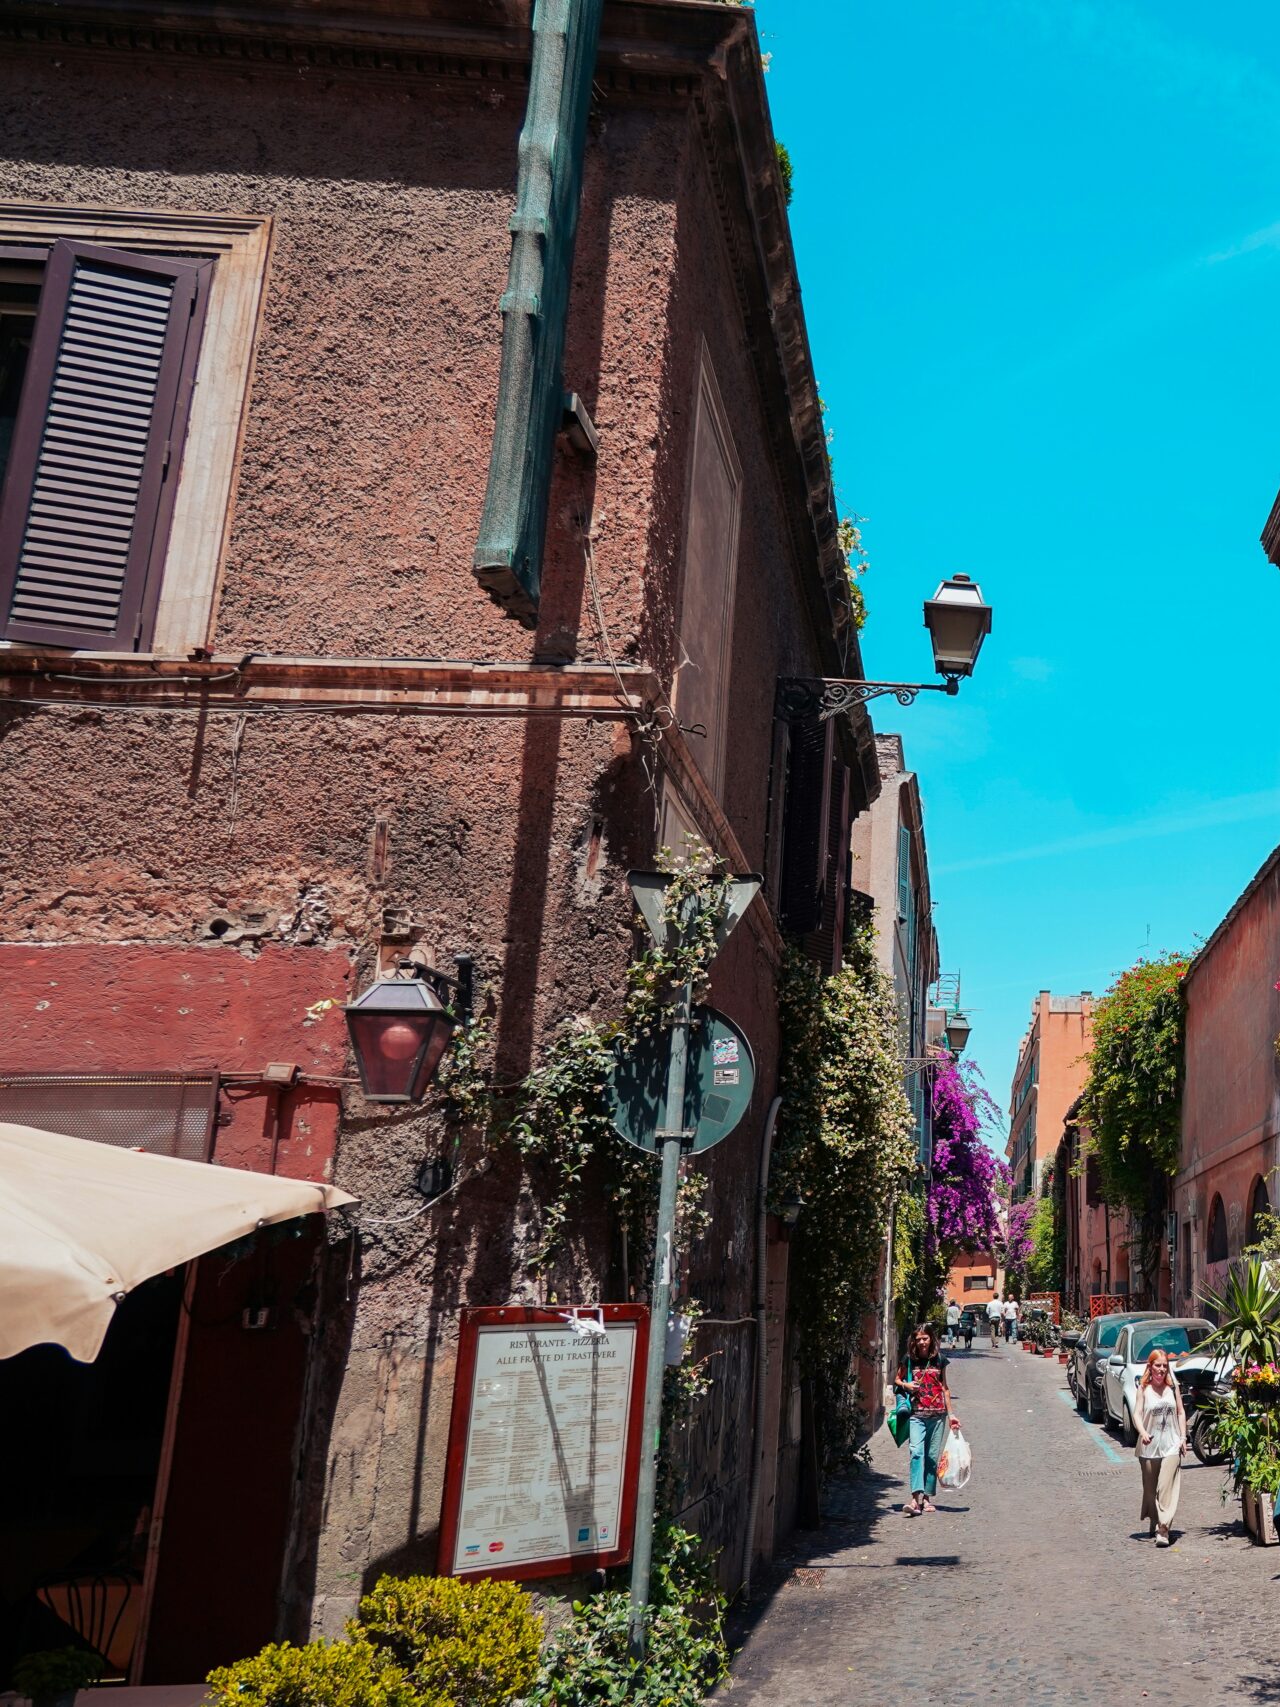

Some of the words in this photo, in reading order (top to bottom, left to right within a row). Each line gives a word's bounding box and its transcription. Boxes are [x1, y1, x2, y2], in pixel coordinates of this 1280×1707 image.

[510, 1339, 566, 1349] RISTORANTE
[572, 1337, 610, 1347] PIZZERIA
[496, 1356, 519, 1365] ALLE
[520, 1354, 551, 1364] FRATTE
[553, 1353, 564, 1361] DI
[567, 1350, 617, 1361] TRASTEVERE
